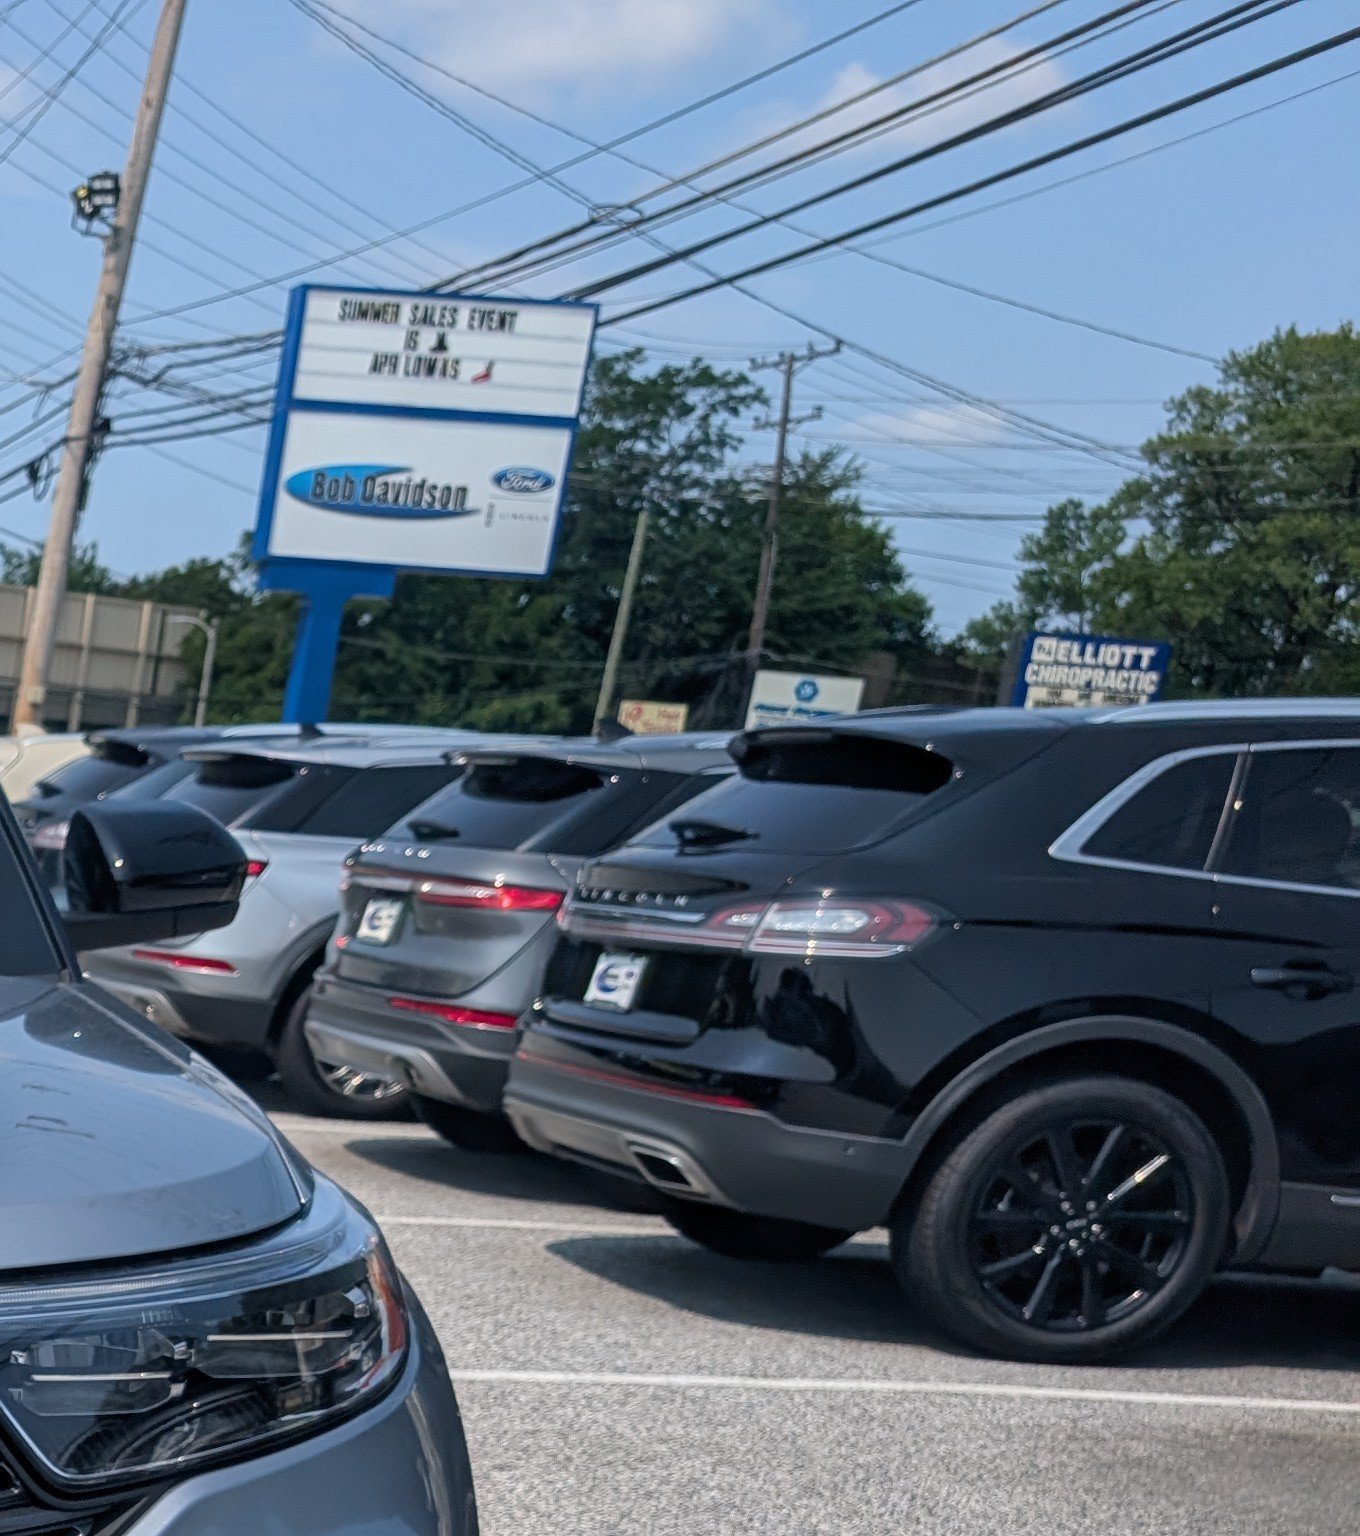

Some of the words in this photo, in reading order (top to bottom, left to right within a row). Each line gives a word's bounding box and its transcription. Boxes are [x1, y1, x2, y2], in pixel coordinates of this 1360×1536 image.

[338, 299, 400, 324] SUMMER
[408, 303, 459, 328] SALES
[467, 307, 519, 333] EVENT
[311, 470, 355, 502] Bob
[361, 474, 469, 511] Davidson
[1057, 640, 1157, 670] ELLIOTT
[1025, 663, 1160, 695] CHIROPRACTIC
